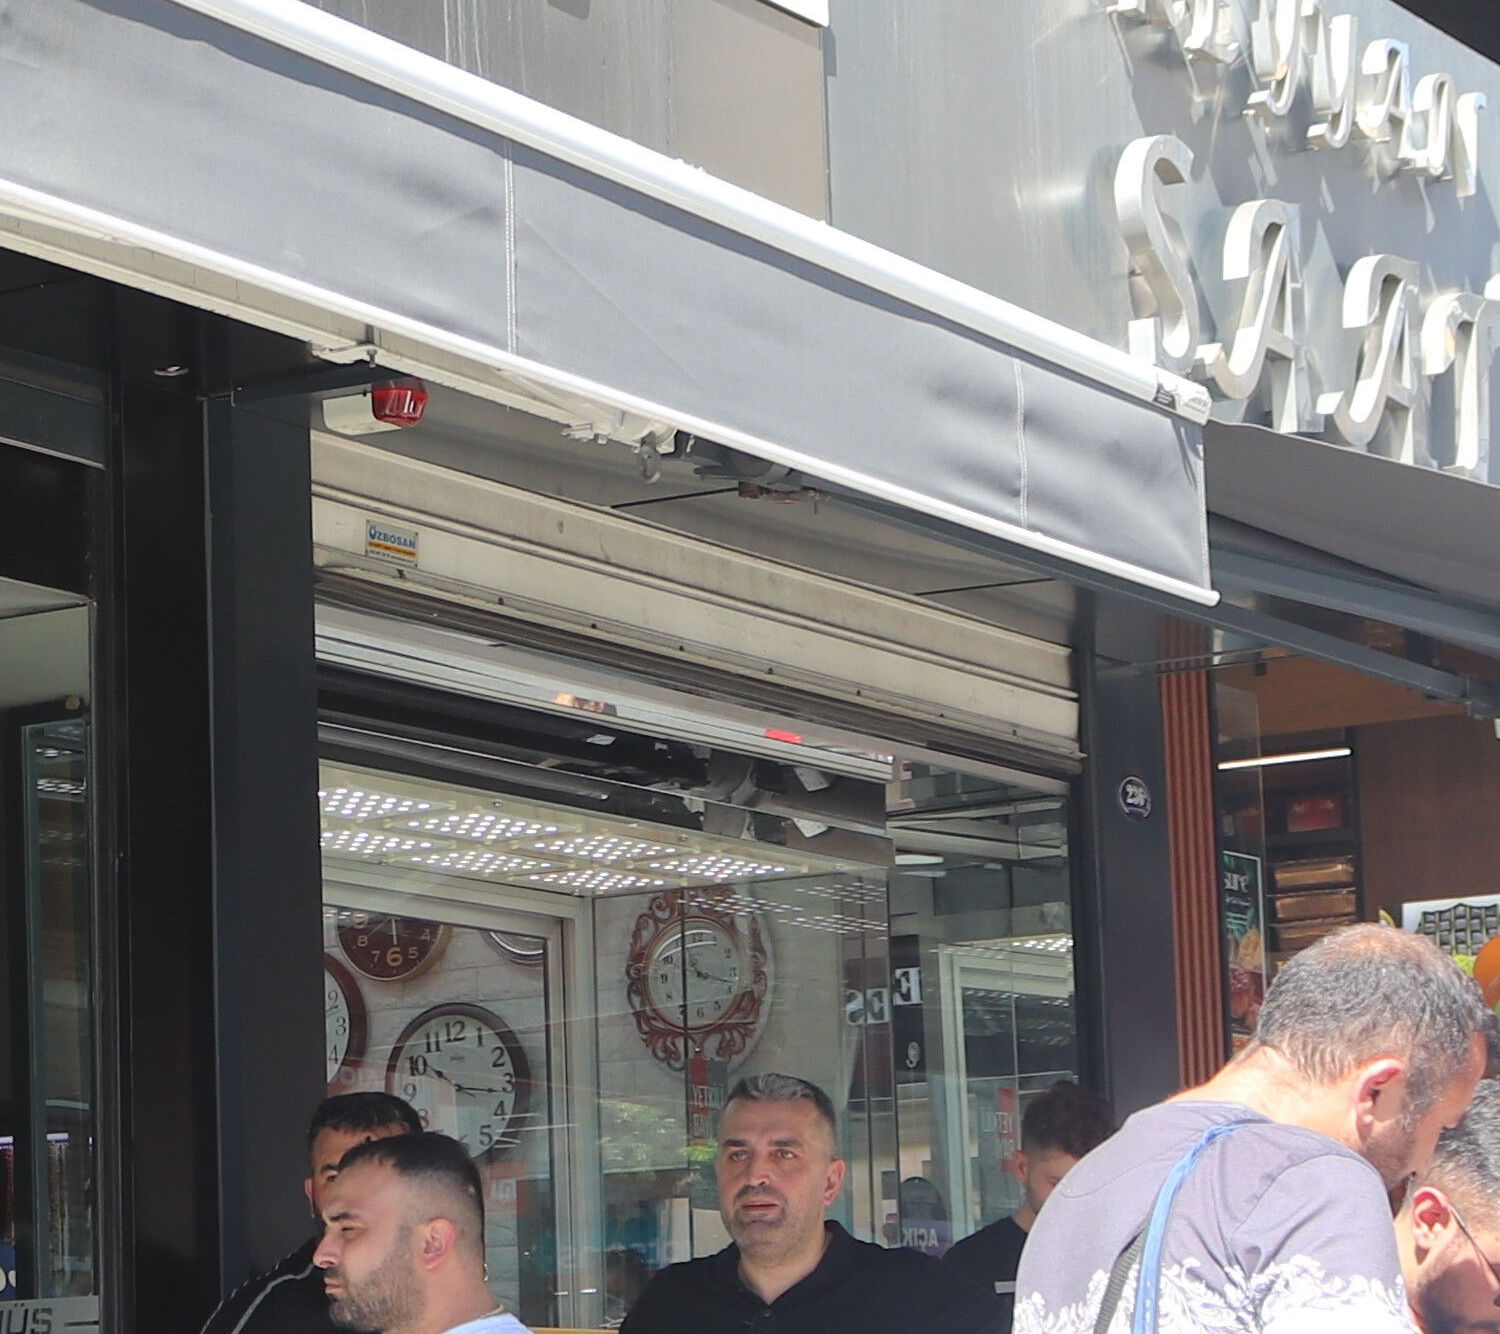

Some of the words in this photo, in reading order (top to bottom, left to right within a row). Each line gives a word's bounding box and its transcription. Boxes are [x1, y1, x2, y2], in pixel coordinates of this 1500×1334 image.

[386, 950, 403, 967] 6
[445, 1021, 466, 1043] 12
[491, 1047, 505, 1068] 2
[493, 1100, 507, 1121] 4
[480, 1125, 494, 1146] 5
